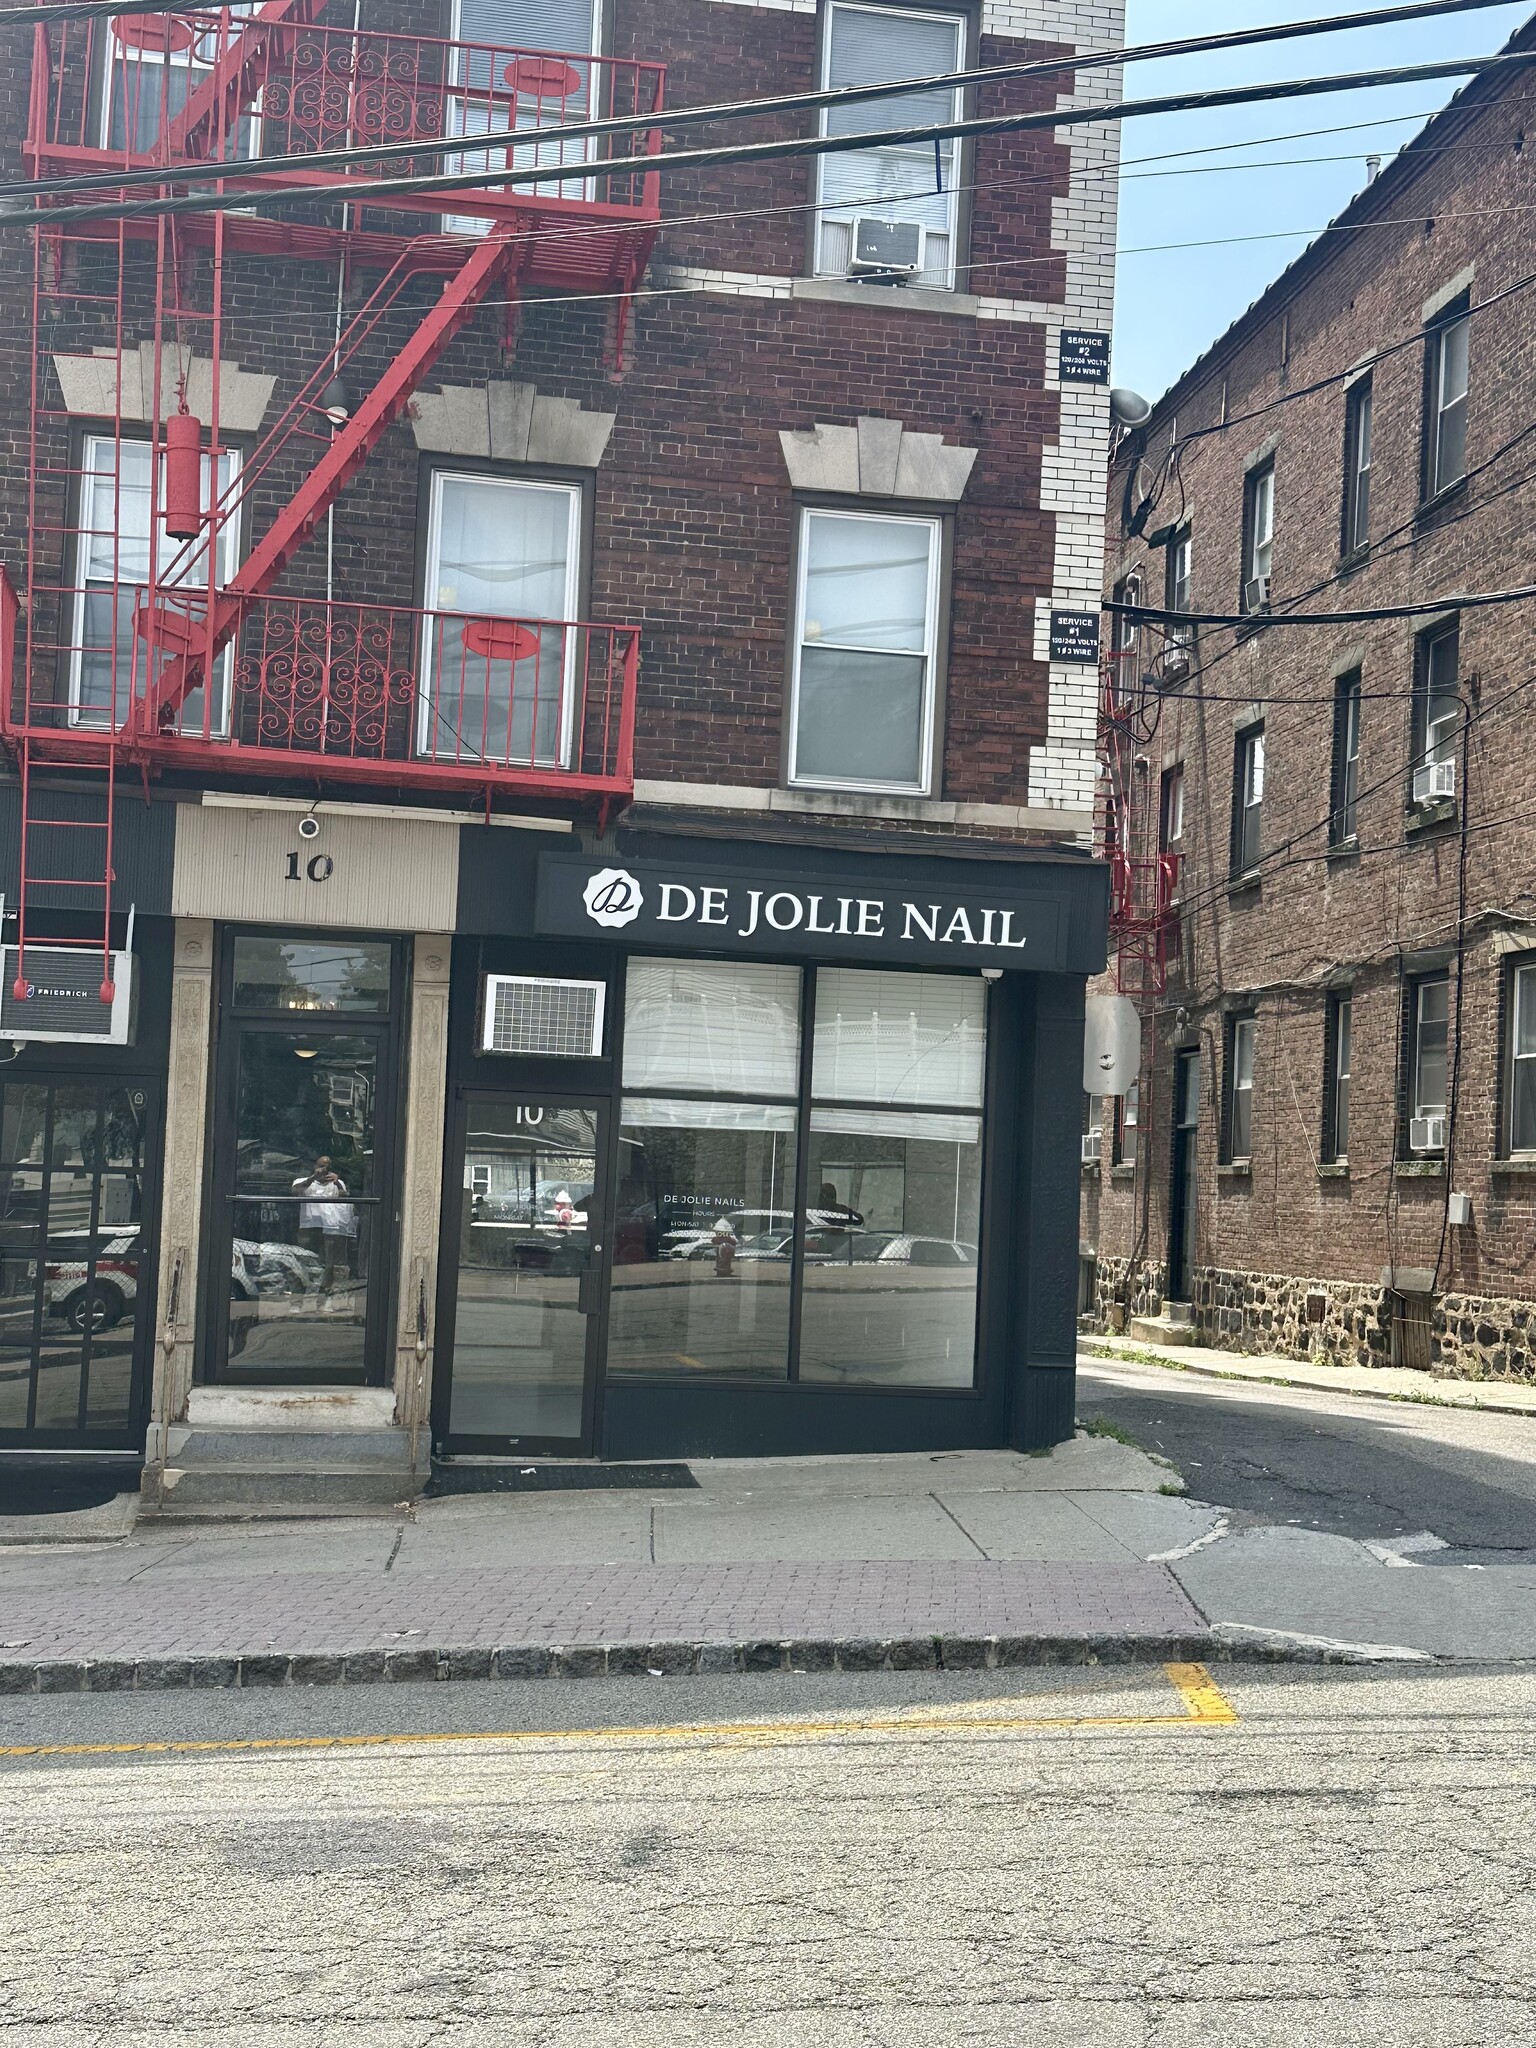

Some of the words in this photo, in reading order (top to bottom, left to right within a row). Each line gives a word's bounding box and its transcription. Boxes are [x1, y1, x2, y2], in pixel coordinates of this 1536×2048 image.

[1067, 336, 1103, 346] SERVICE
[1079, 347, 1090, 356] #2
[1082, 368, 1101, 376] WIRE
[1057, 617, 1093, 627] SERVICE
[1069, 627, 1079, 637] #1
[1051, 637, 1076, 645] 120/240
[1073, 648, 1092, 656] WIRE
[284, 851, 334, 882] 10
[655, 883, 730, 925] DE
[737, 890, 885, 937] JOLIE
[900, 902, 1027, 948] NAIL
[38, 988, 88, 998] FRIEDRICH
[516, 1105, 544, 1125] 10
[663, 1194, 678, 1203] DE
[681, 1195, 711, 1205] JOLIE
[714, 1197, 745, 1207] NAILS
